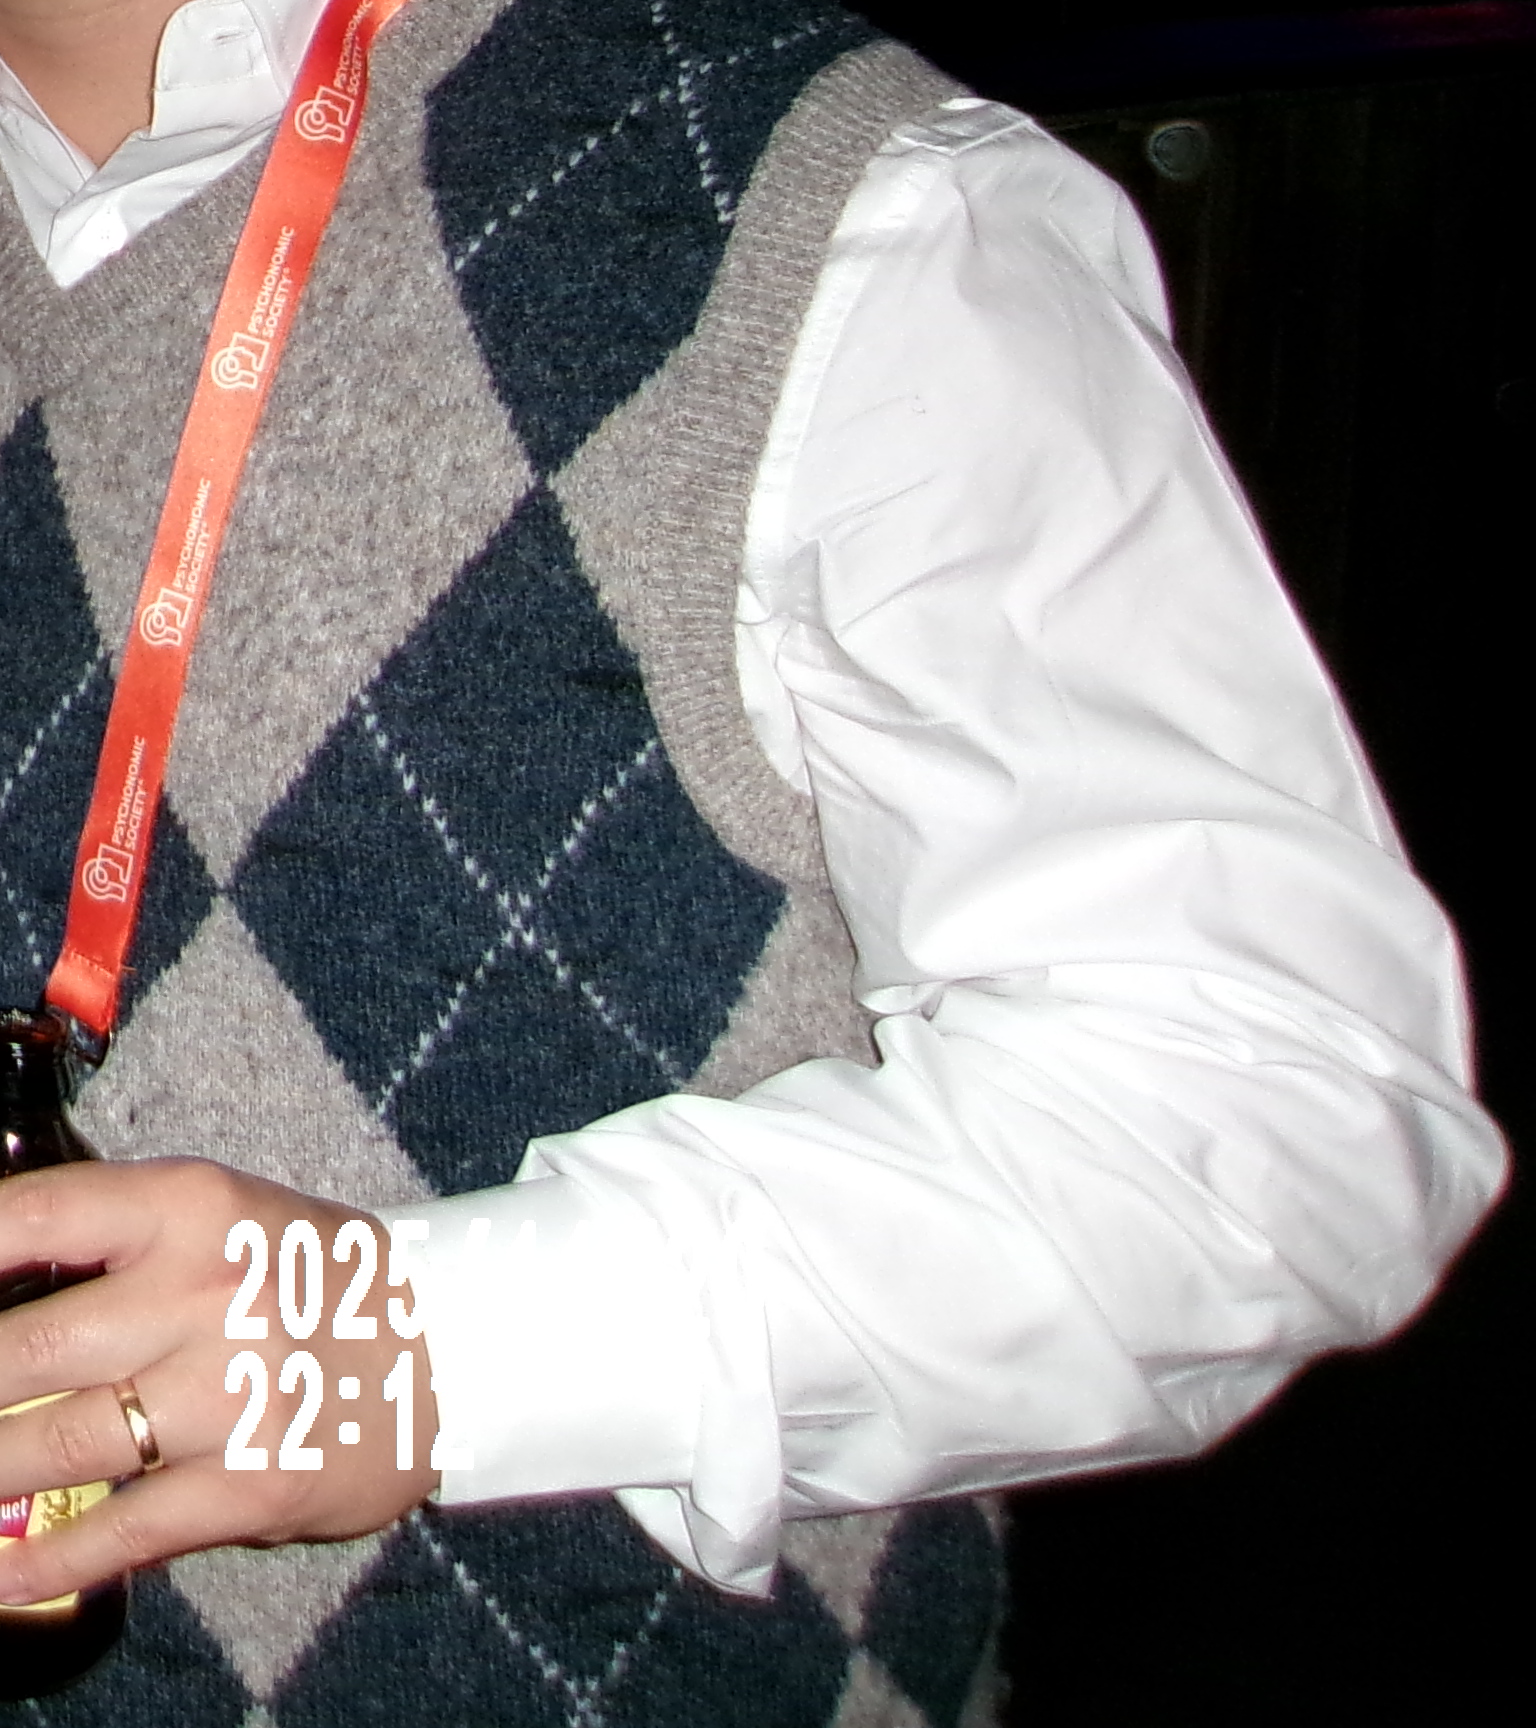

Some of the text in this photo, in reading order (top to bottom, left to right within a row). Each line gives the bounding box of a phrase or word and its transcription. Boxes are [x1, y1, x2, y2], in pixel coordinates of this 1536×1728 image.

[247, 226, 295, 336] PSYCHONOMIC
[173, 477, 212, 589] PSYCHONOMIC
[111, 735, 147, 846] PSYCHONOMIC
